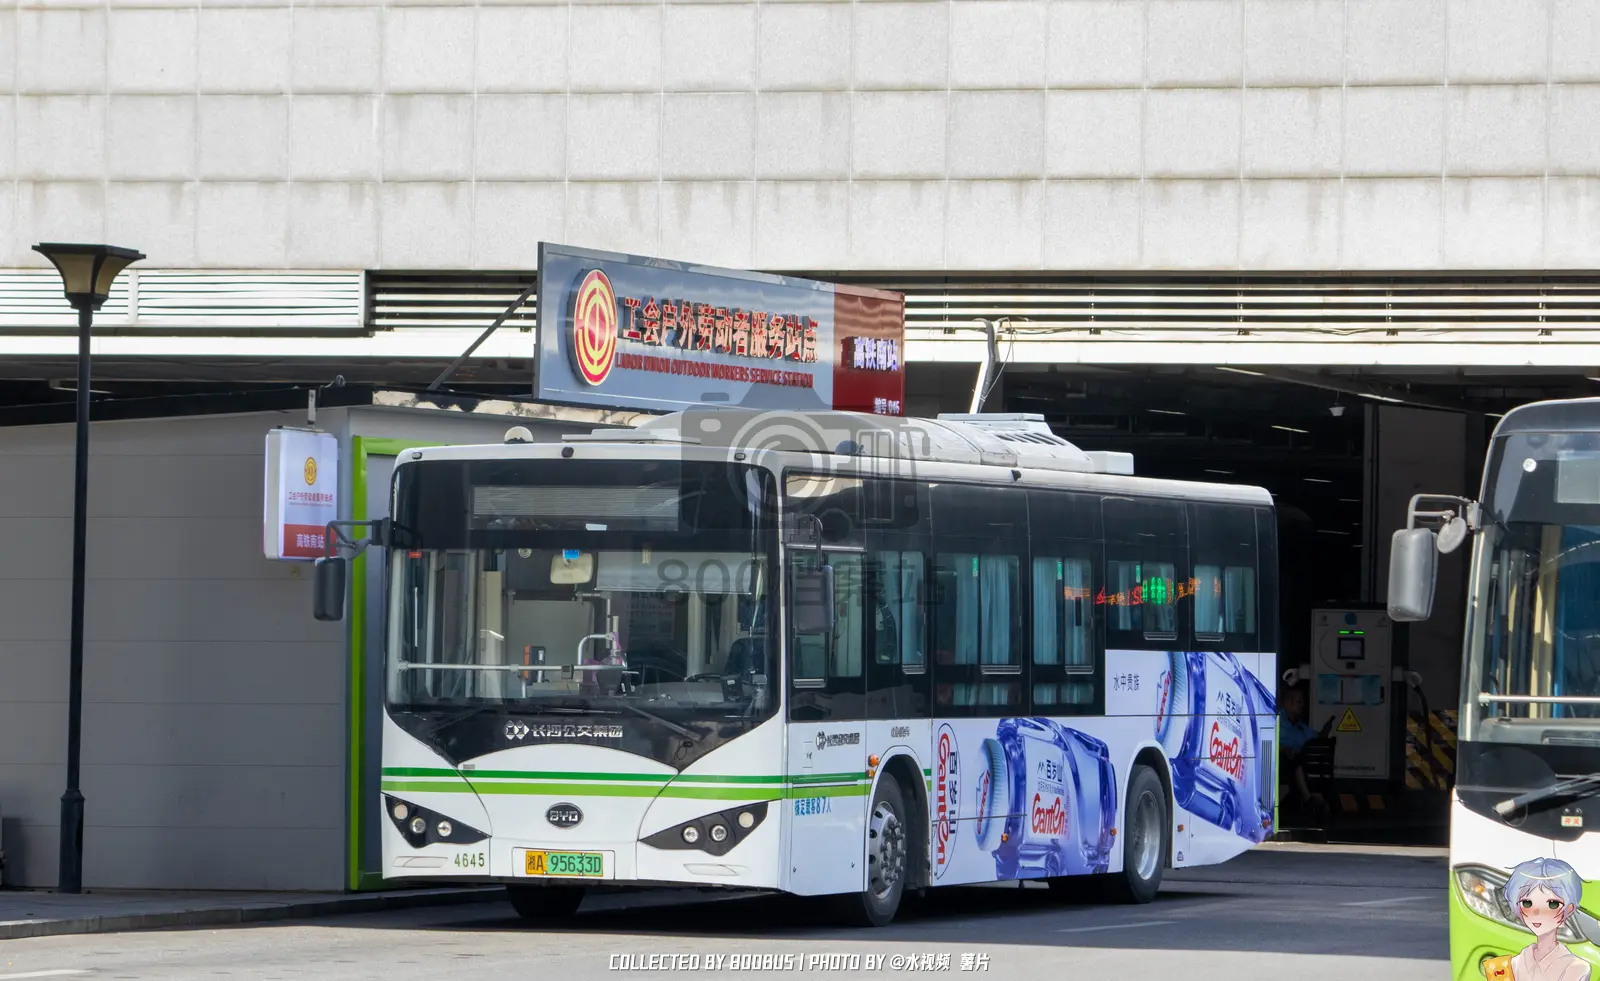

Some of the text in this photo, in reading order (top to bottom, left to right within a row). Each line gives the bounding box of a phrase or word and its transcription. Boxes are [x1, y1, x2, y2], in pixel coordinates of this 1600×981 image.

[623, 296, 819, 363] 工会户外劳动者服务站点
[854, 336, 898, 371] 高铁南站
[615, 352, 814, 388] LABOR UNION OUTDOOR WORKERS SERVICE STATION
[1114, 672, 1140, 691] 水中贵族
[531, 724, 623, 738] 长沙公交集团
[549, 810, 579, 822] BYD
[454, 853, 485, 868] 4645
